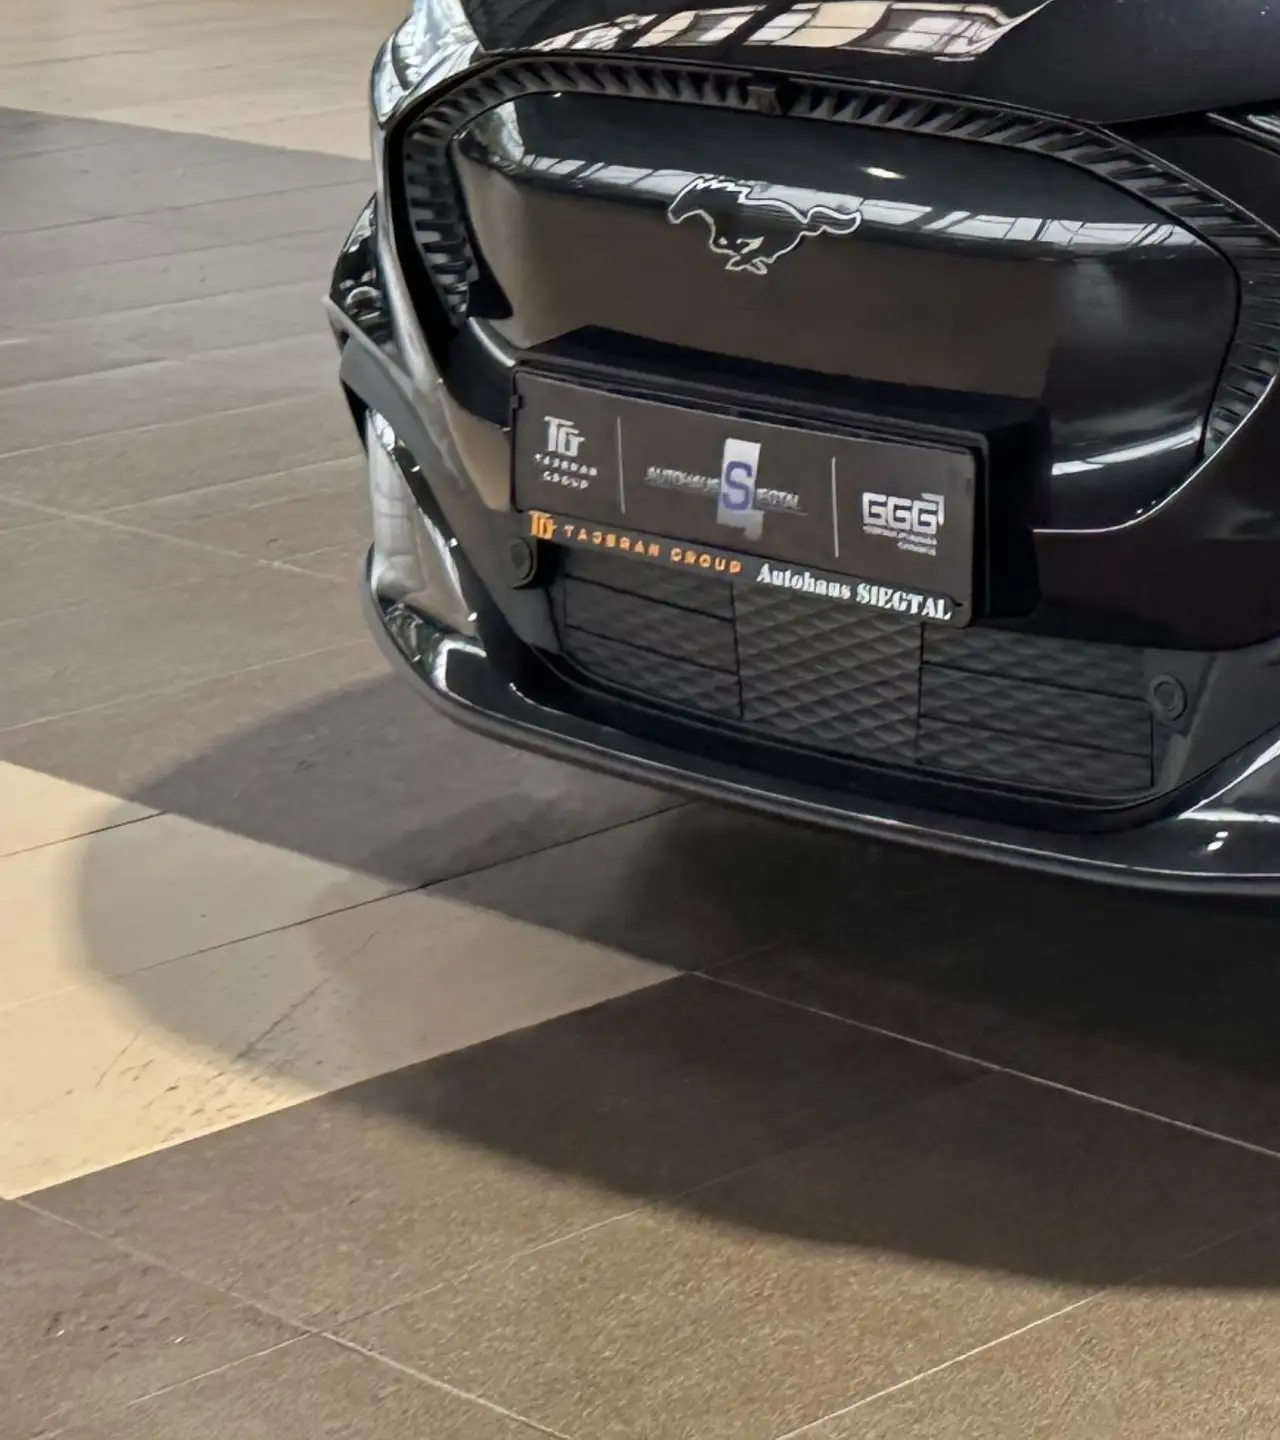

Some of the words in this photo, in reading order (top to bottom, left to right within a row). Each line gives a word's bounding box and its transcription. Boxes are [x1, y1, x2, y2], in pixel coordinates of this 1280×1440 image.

[543, 470, 589, 490] GROUP
[863, 491, 938, 535] GGG
[670, 546, 743, 574] GROUP
[756, 562, 852, 600] Autohaus
[856, 582, 952, 621] SIEGTAL
